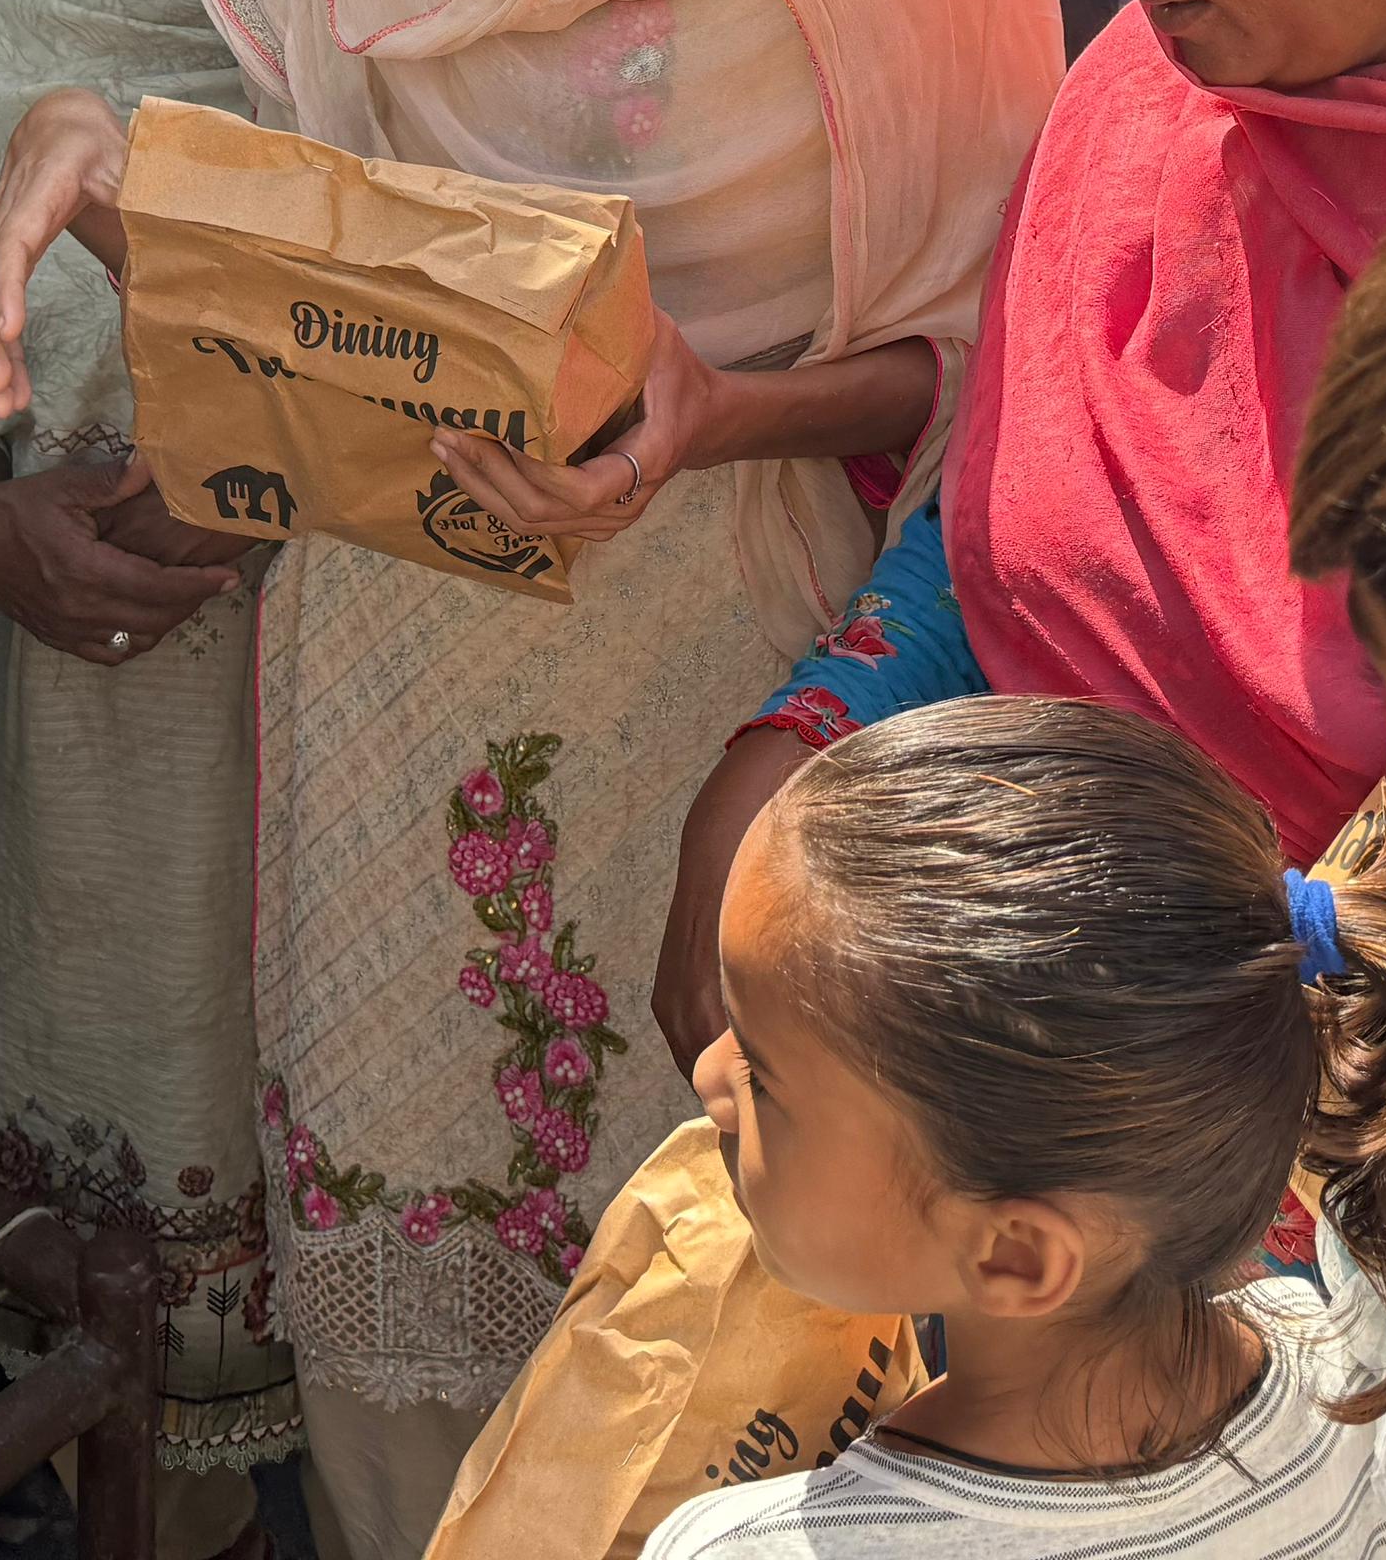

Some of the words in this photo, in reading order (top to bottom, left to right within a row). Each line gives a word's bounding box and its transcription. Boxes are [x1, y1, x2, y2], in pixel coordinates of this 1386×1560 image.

[290, 301, 442, 383] Dining
[436, 516, 478, 532] Hot
[487, 514, 509, 534] &
